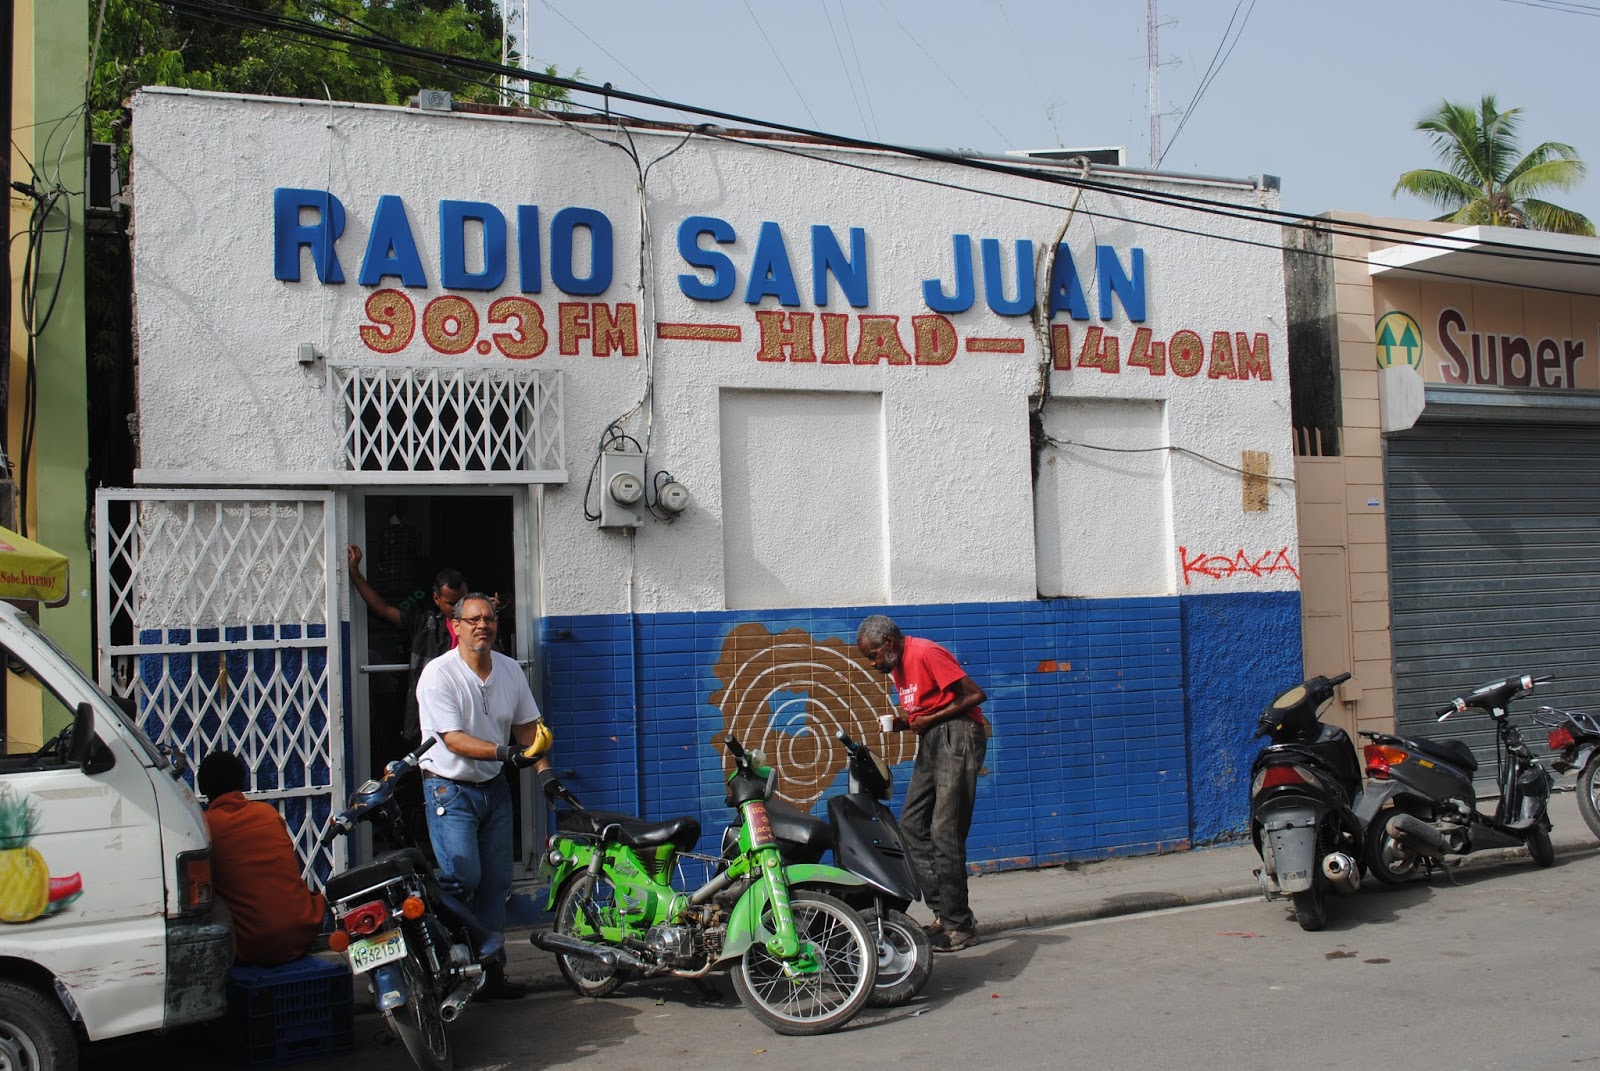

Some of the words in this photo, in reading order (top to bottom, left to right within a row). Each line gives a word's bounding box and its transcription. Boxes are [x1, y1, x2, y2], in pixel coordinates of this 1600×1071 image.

[273, 187, 613, 296] RADIO
[677, 215, 868, 308] SAN
[922, 233, 1146, 322] JUAN
[755, 310, 958, 365] HIAD
